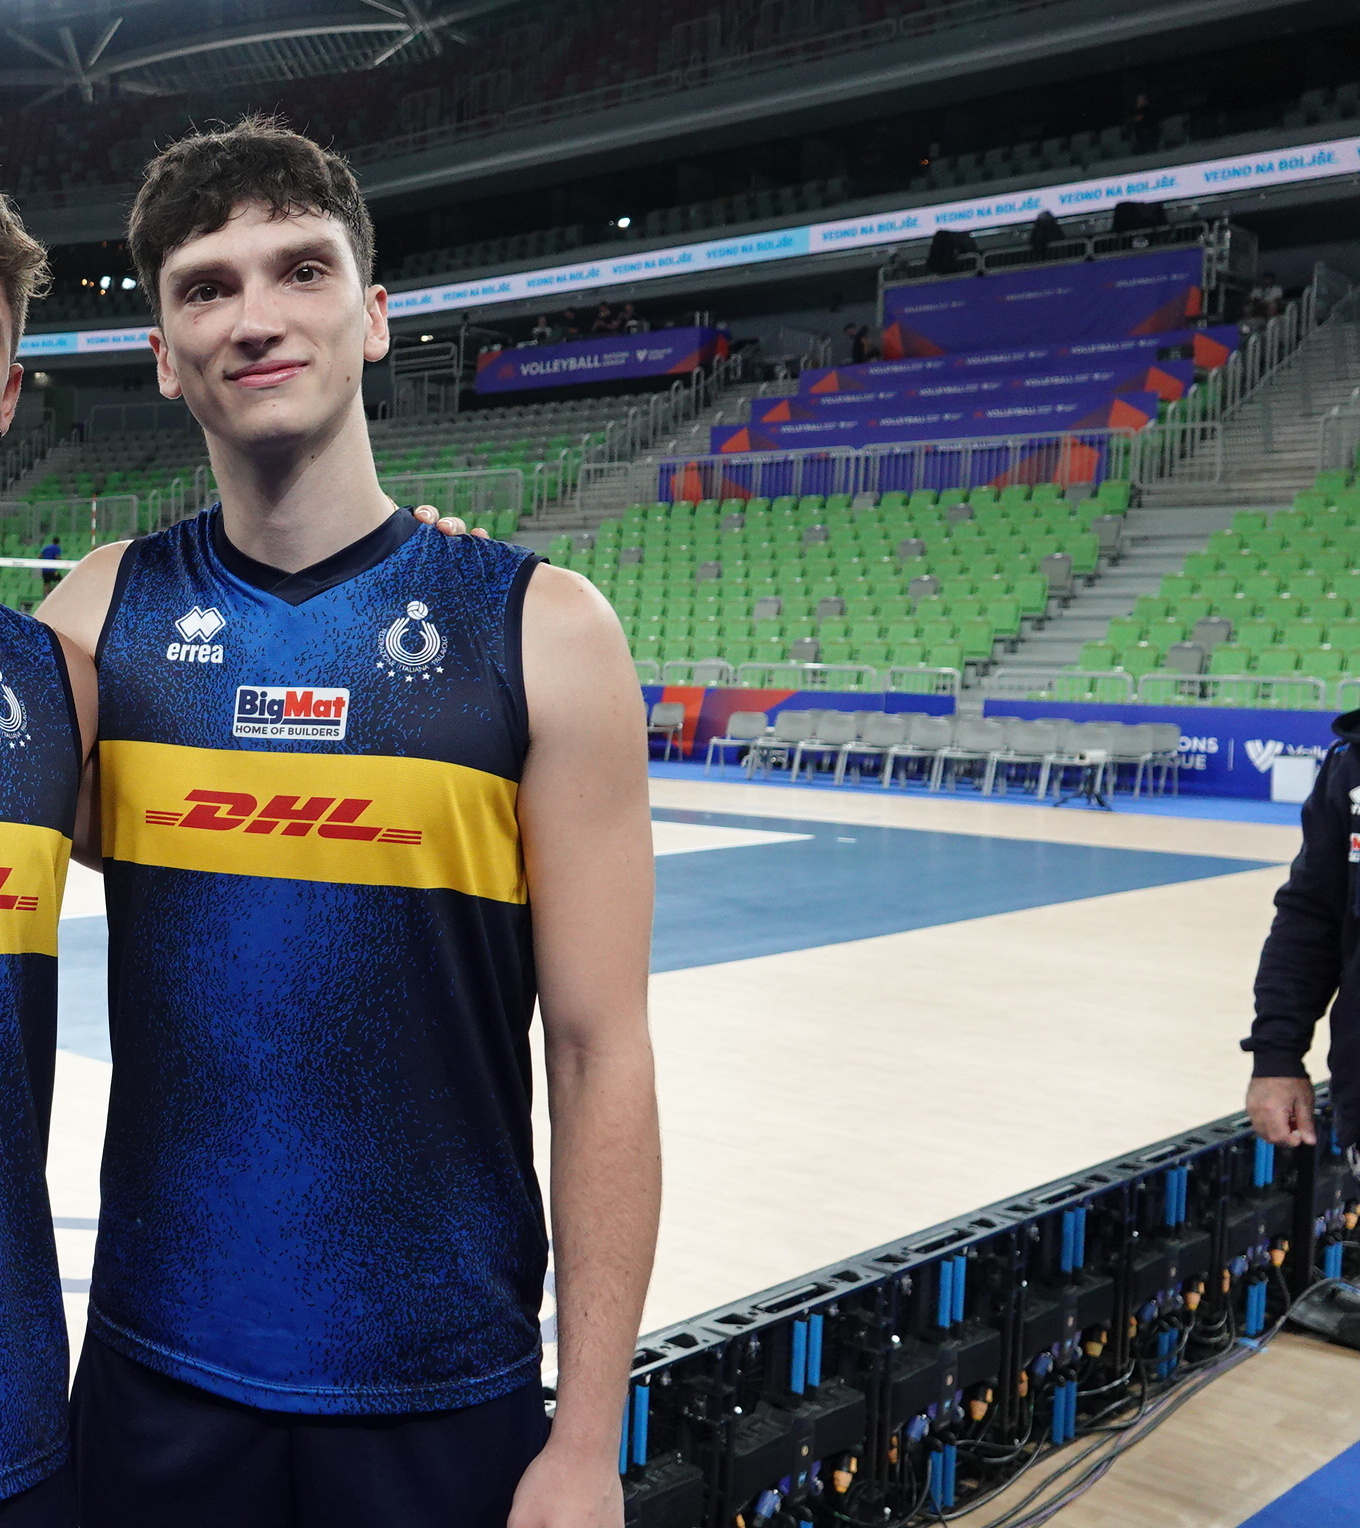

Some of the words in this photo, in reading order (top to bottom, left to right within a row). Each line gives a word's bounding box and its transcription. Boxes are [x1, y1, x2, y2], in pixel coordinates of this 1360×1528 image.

[1203, 165, 1251, 183] VEDNO
[1255, 162, 1275, 174] NA
[1059, 188, 1103, 206] VEDNO
[1105, 185, 1123, 197] NA
[935, 211, 974, 224] VEDNO
[976, 208, 992, 218] NA
[821, 227, 858, 241] VEDNO
[860, 225, 874, 235] NA
[520, 354, 601, 376] VOLLEYBALL
[238, 689, 346, 725] BigMat
[235, 725, 268, 735] HOME
[271, 726, 285, 735] OF
[288, 727, 340, 737] BUILDERS
[178, 789, 383, 842] DHL
